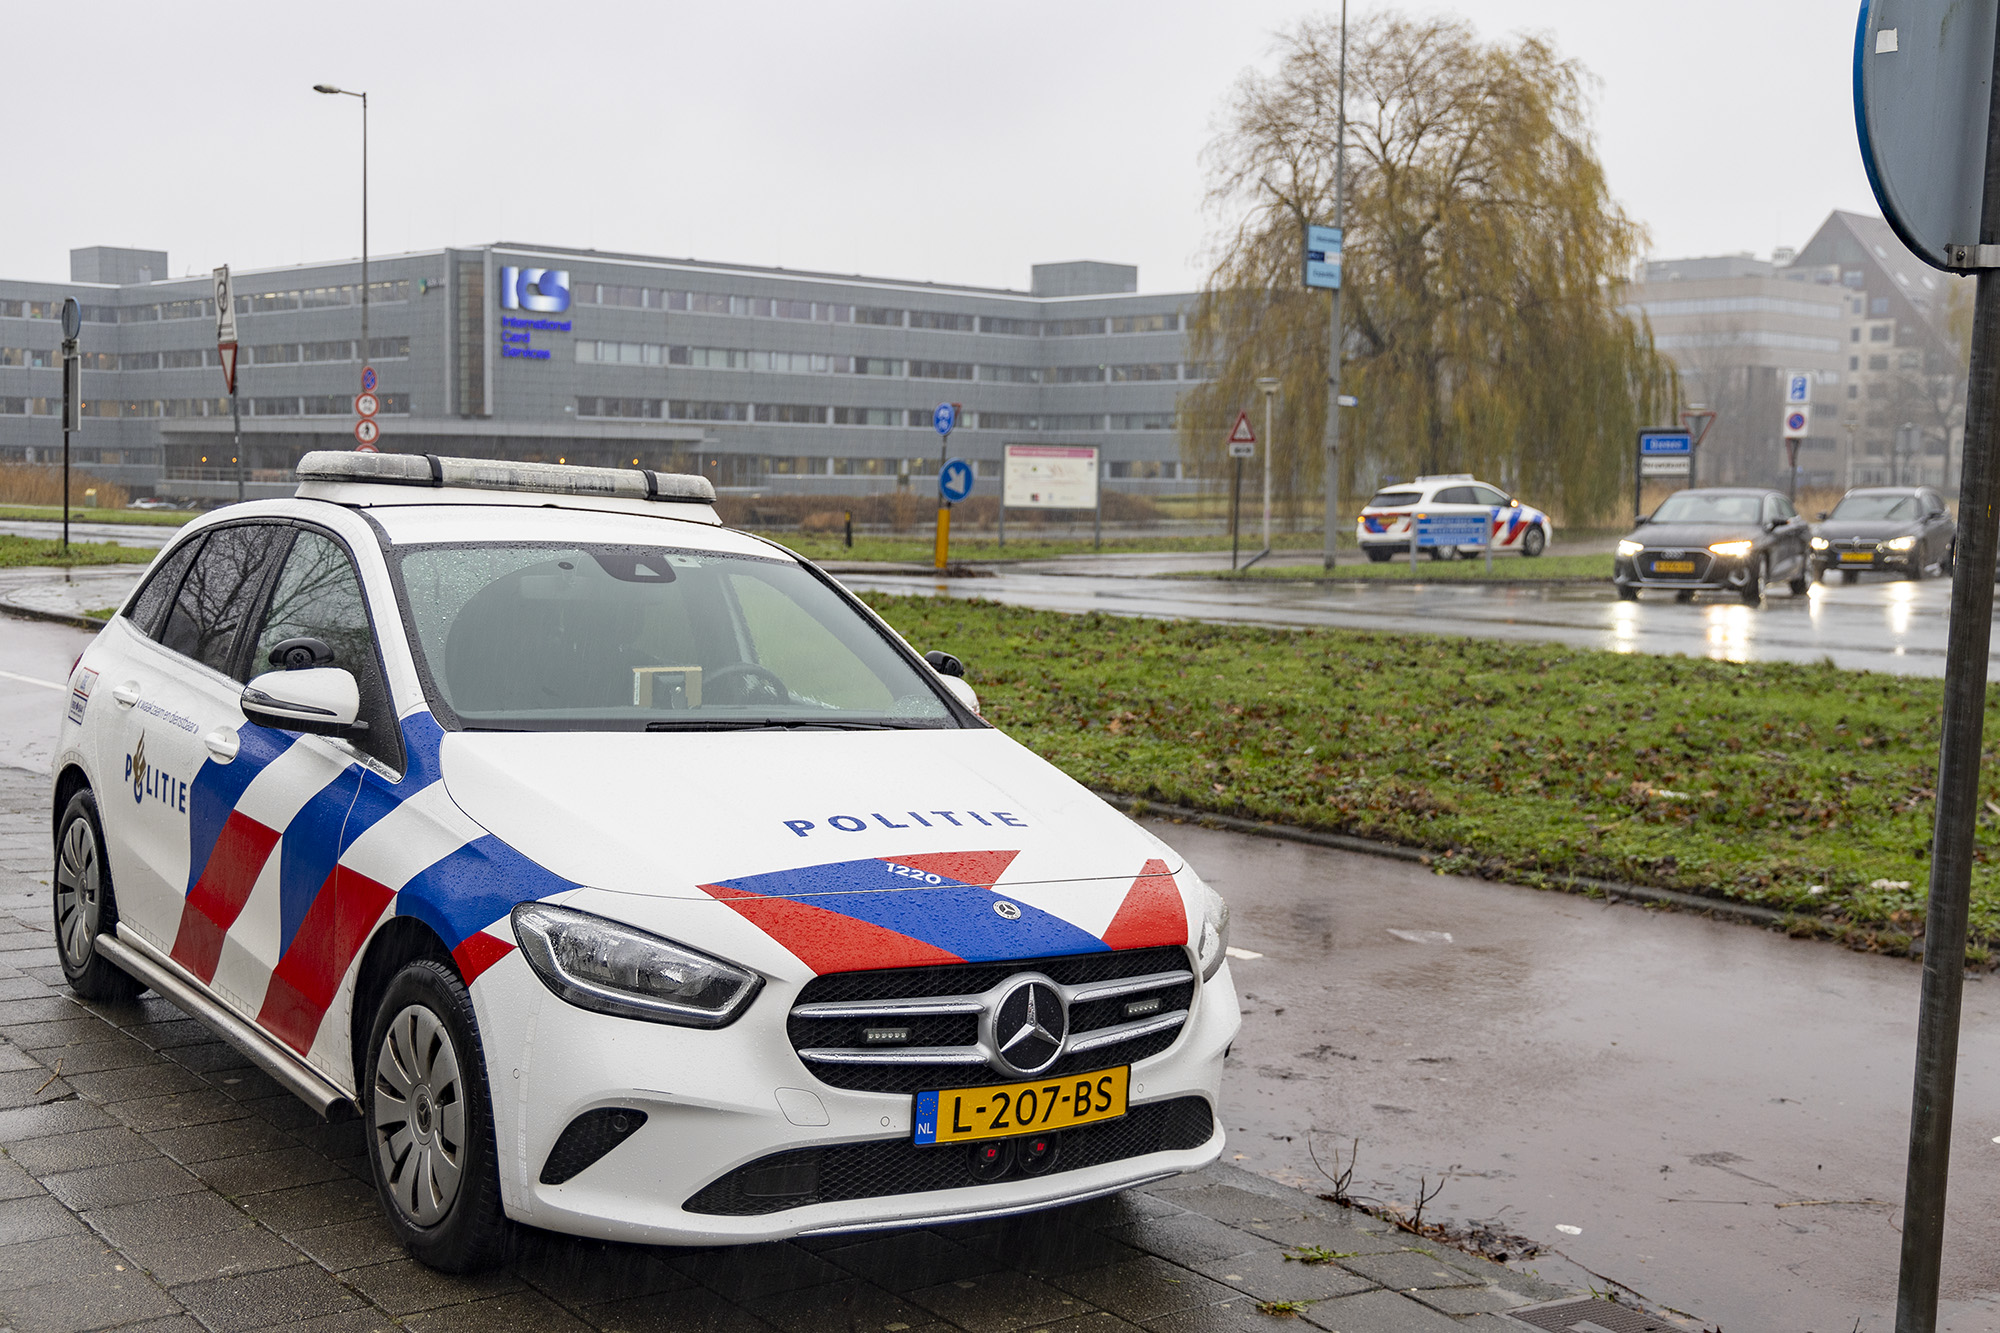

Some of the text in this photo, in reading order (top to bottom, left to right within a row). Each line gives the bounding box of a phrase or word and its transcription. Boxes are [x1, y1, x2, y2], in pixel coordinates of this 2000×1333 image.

[502, 330, 531, 344] Card
[502, 344, 551, 360] Services
[125, 753, 187, 814] POLITIE
[782, 810, 1029, 838] POLITIE
[885, 862, 942, 885] 1220
[917, 1076, 1113, 1136] NL L-207-BS
